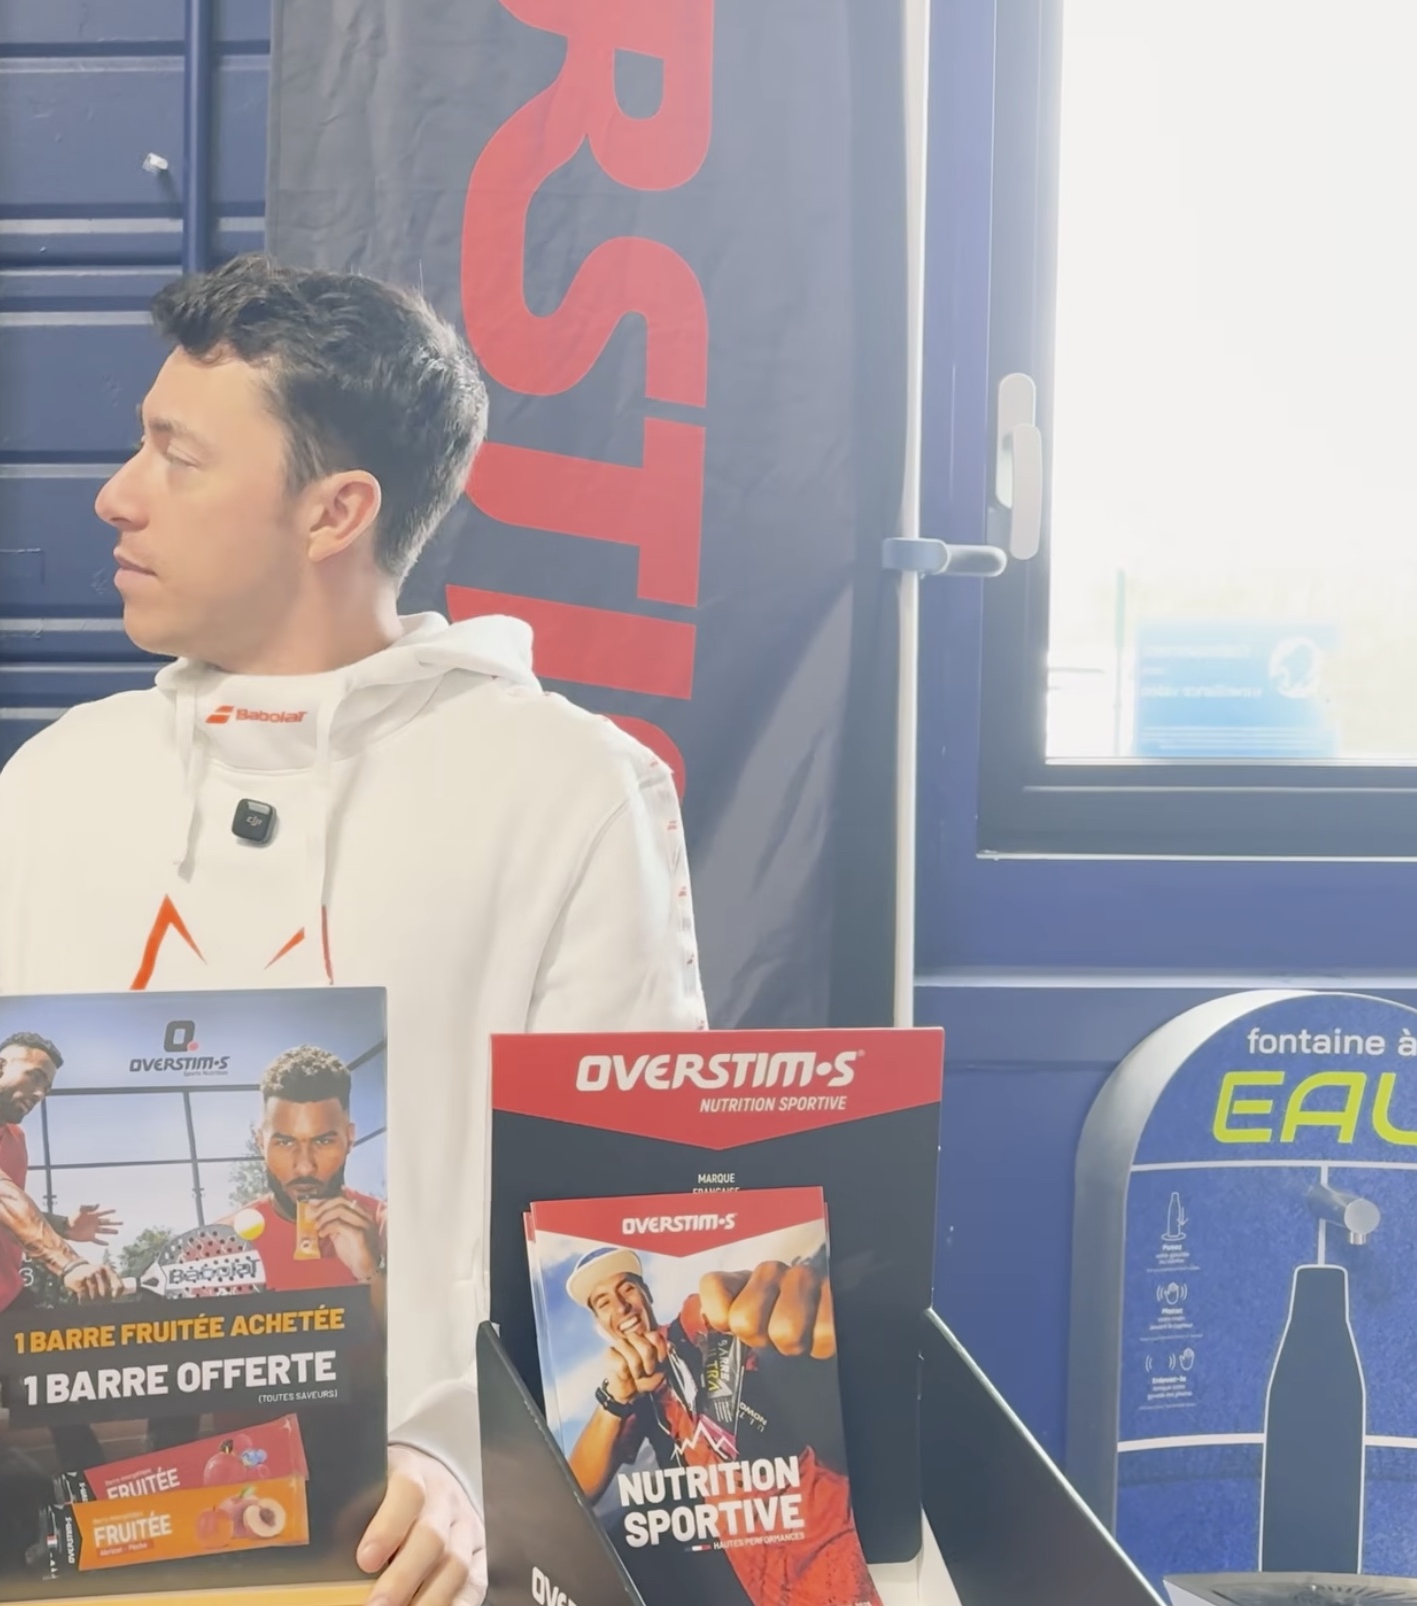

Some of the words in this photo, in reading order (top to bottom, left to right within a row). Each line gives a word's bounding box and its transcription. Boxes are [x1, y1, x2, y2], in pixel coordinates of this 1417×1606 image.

[1247, 1028, 1385, 1055] fontaine
[699, 1096, 777, 1113] NUTRITION
[778, 1095, 847, 1112] SPORTIVE
[698, 1173, 735, 1184] MARQUE
[14, 1333, 24, 1354] 1
[30, 1325, 116, 1354] BARRE
[122, 1313, 225, 1345] FRUITÉE
[230, 1303, 345, 1337] ACHETÉE
[24, 1375, 38, 1406] 1
[46, 1364, 169, 1404] BARRE
[177, 1351, 337, 1393] OFFERTE
[259, 1393, 292, 1404] (TOUTES
[296, 1389, 338, 1400] SAVEURS)
[106, 1466, 181, 1500] FRUITÉE
[618, 1455, 800, 1507] NUTRITION
[94, 1510, 172, 1548] FRUITÉE
[624, 1494, 805, 1548] SPORTIVE
[713, 1539, 744, 1550] HAUTES
[744, 1532, 805, 1547] PERFORMANCES
